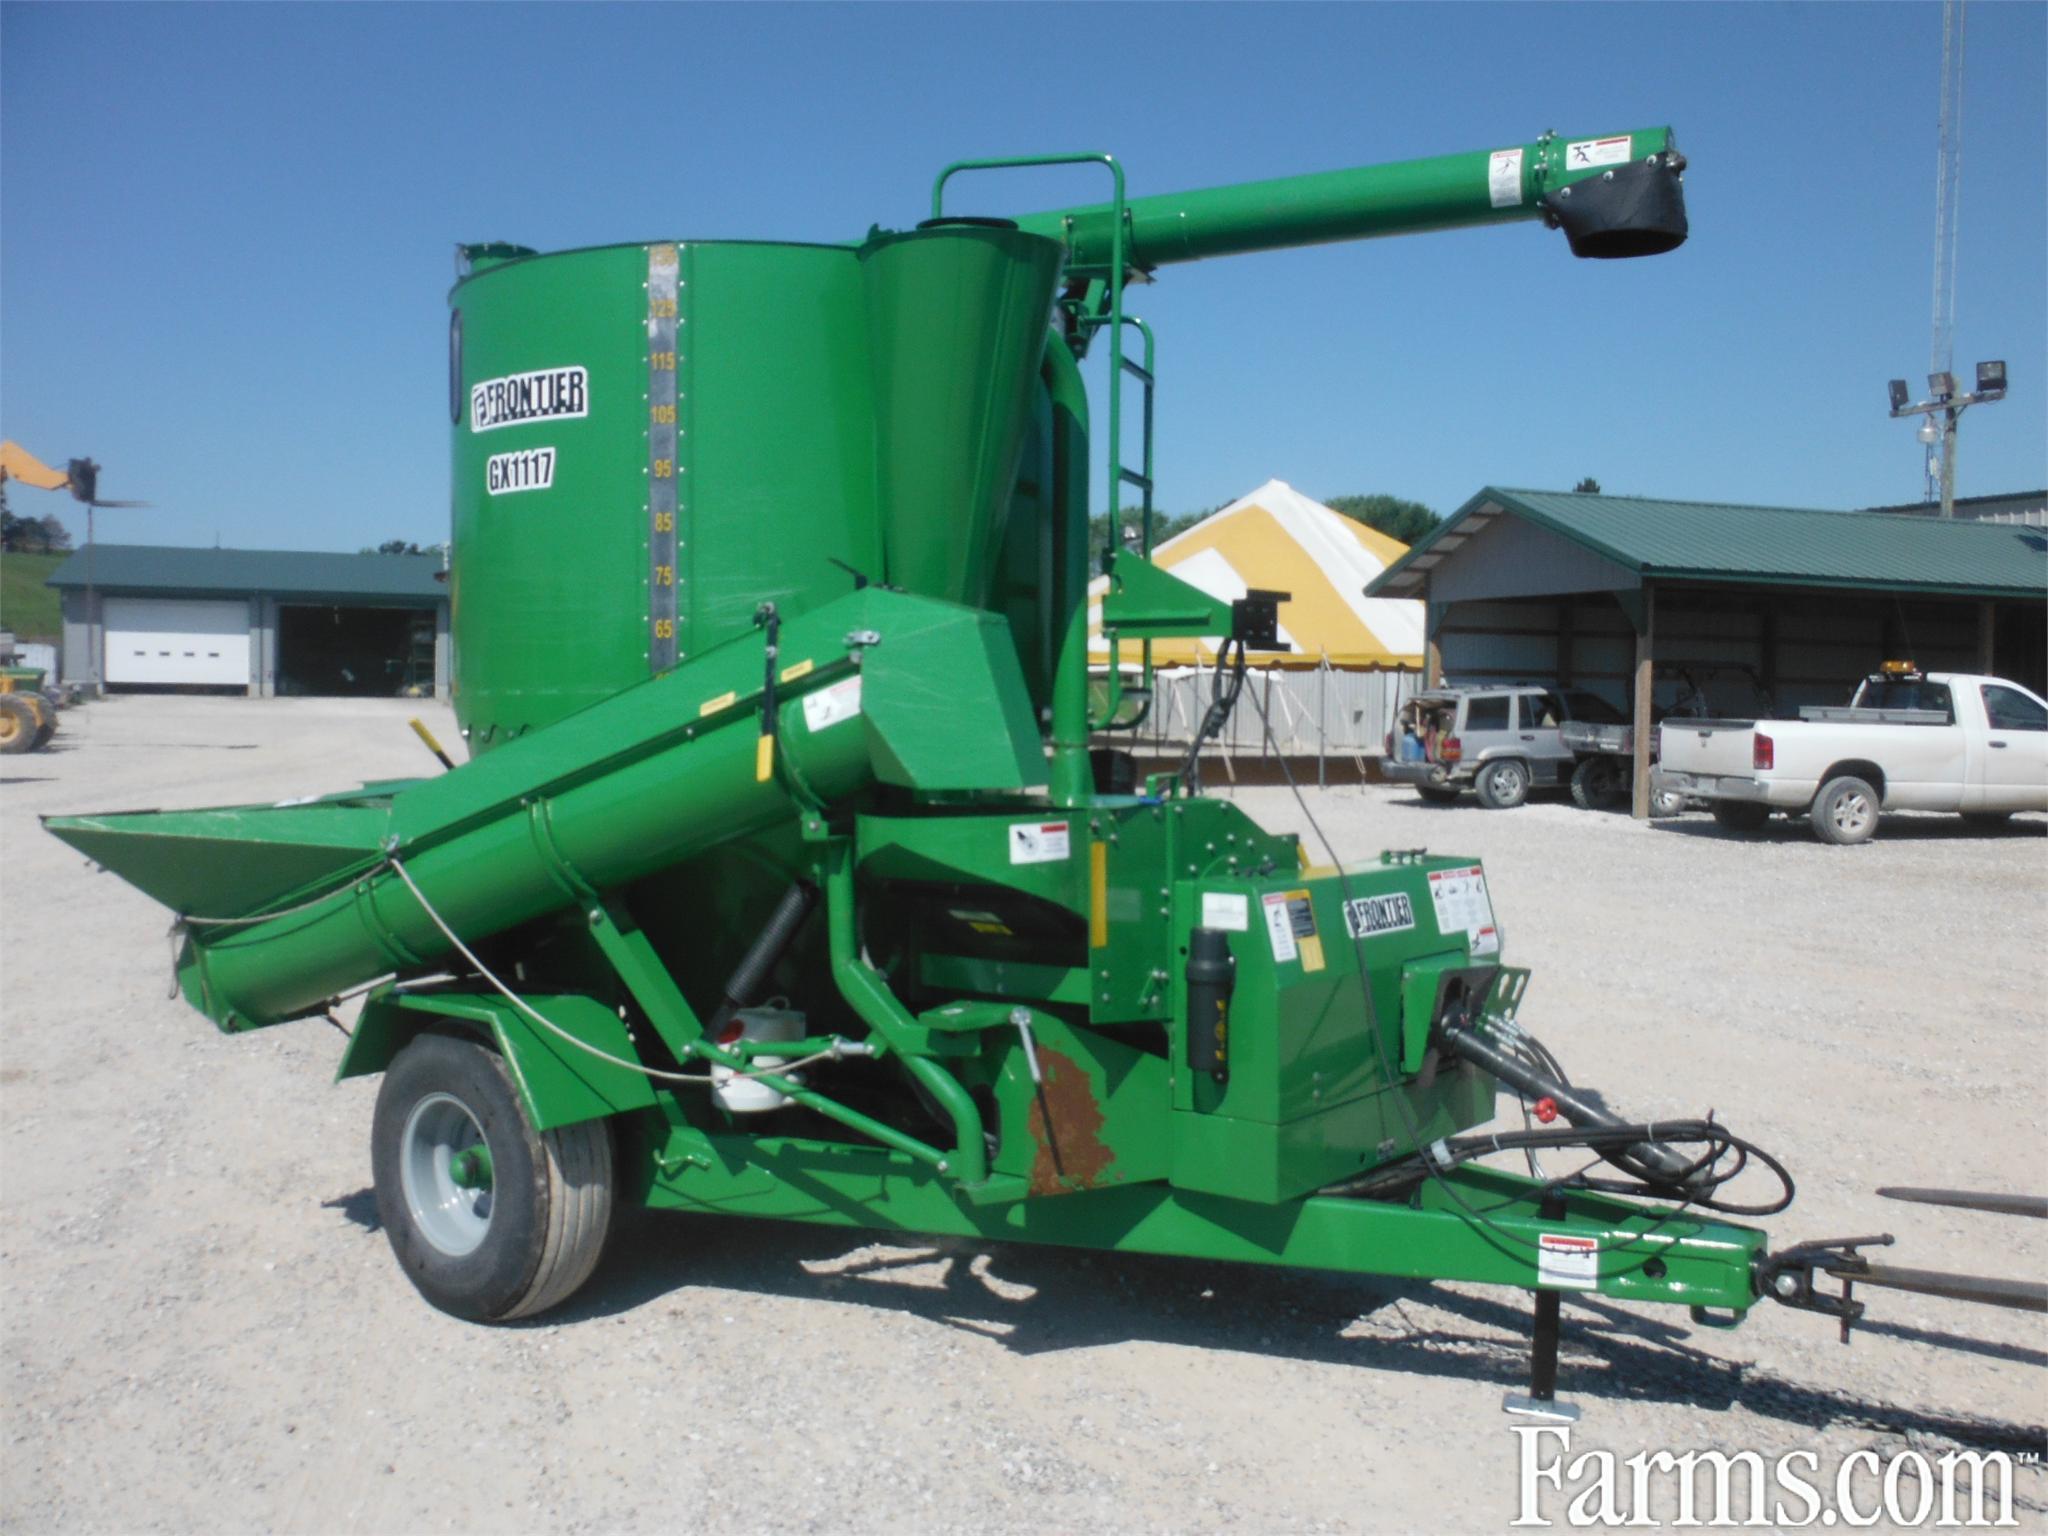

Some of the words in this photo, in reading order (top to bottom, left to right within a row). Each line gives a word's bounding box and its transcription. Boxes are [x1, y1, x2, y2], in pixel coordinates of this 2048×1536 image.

[651, 352, 676, 370] 115
[486, 370, 584, 421] FRONTIER
[650, 405, 677, 424] 105
[489, 452, 551, 491] GX1117
[654, 459, 672, 478] 95
[655, 513, 673, 533] 85
[655, 565, 672, 586] 75
[655, 619, 672, 639] 65
[1356, 895, 1413, 930] FRONTIER
